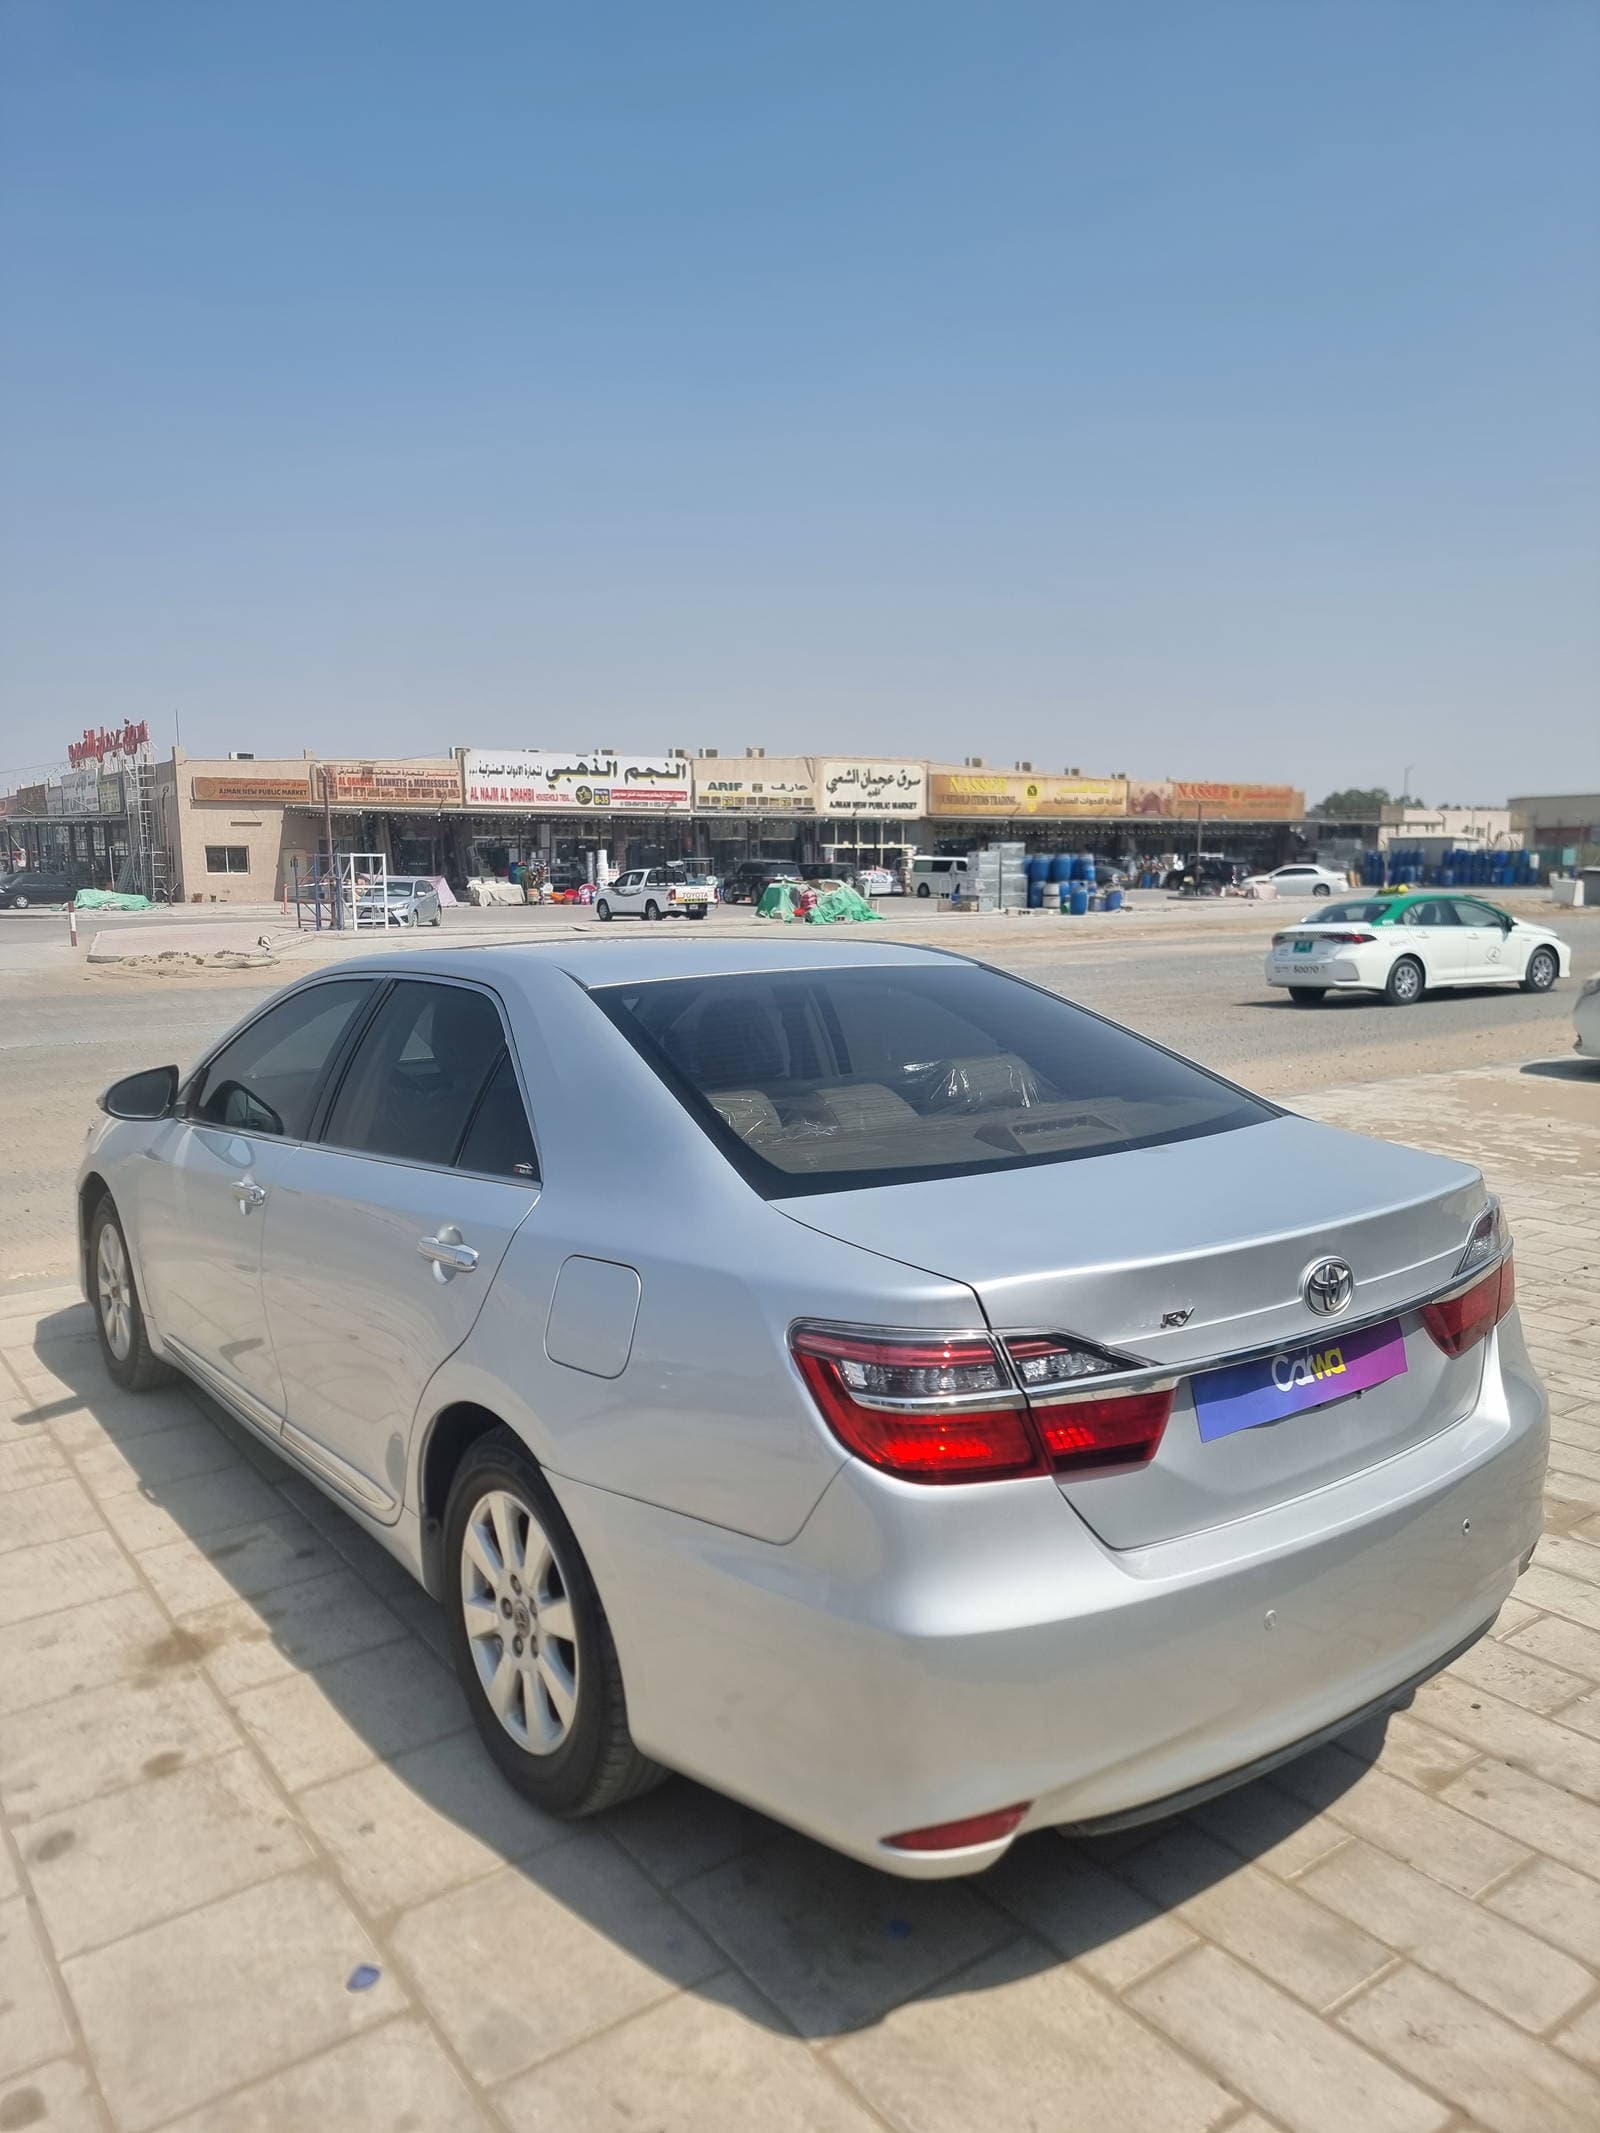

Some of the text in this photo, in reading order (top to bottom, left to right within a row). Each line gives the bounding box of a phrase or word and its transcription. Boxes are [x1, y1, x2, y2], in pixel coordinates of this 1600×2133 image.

[545, 758, 686, 790] النجم الذهبي
[708, 782, 743, 792] ARIF
[826, 768, 921, 794] سوق عجمان الشعبي
[219, 788, 307, 796] AJMAN NEW PUBLIC MARKET
[470, 786, 479, 801] AL
[480, 787, 499, 801] NAJM
[500, 787, 509, 802] AL
[830, 801, 917, 810] AJMAN NEW PUBLIC MARKET
